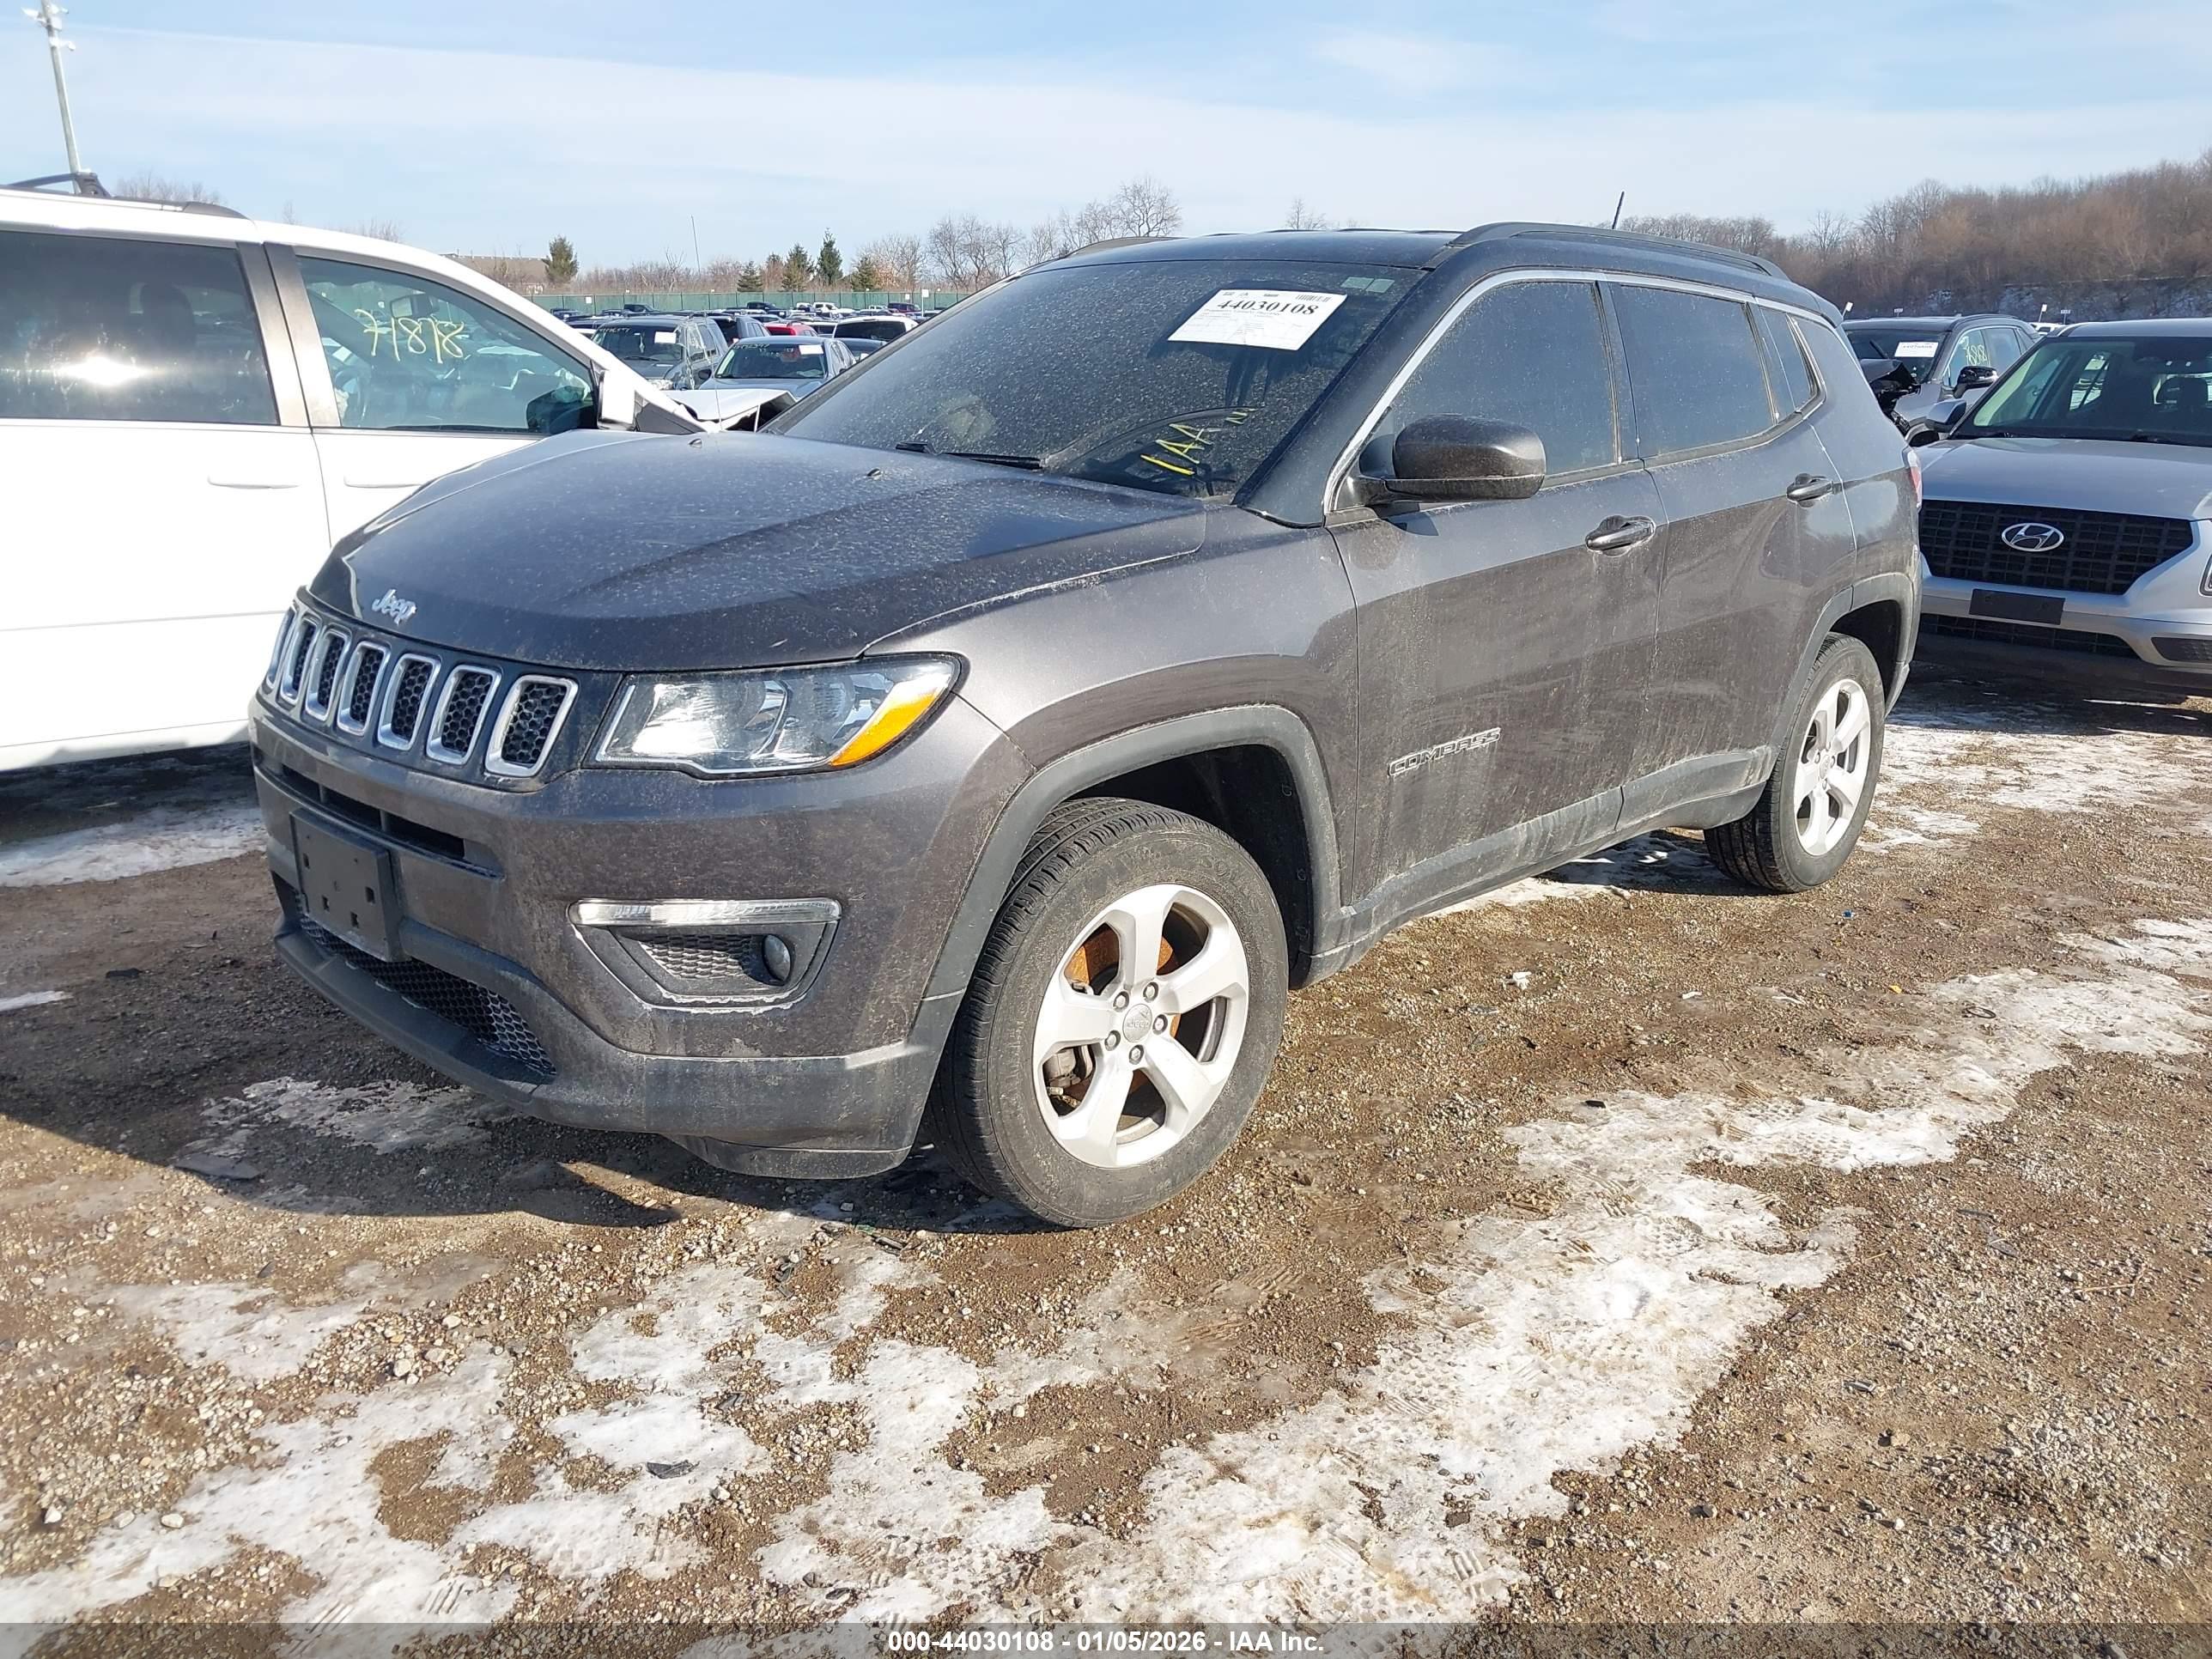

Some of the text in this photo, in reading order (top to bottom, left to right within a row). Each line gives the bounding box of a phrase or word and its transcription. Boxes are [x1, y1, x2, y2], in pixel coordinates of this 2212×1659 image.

[1217, 299, 1319, 315] 44030108
[372, 588, 416, 626] Jeep
[1387, 726, 1502, 776] COMPASS
